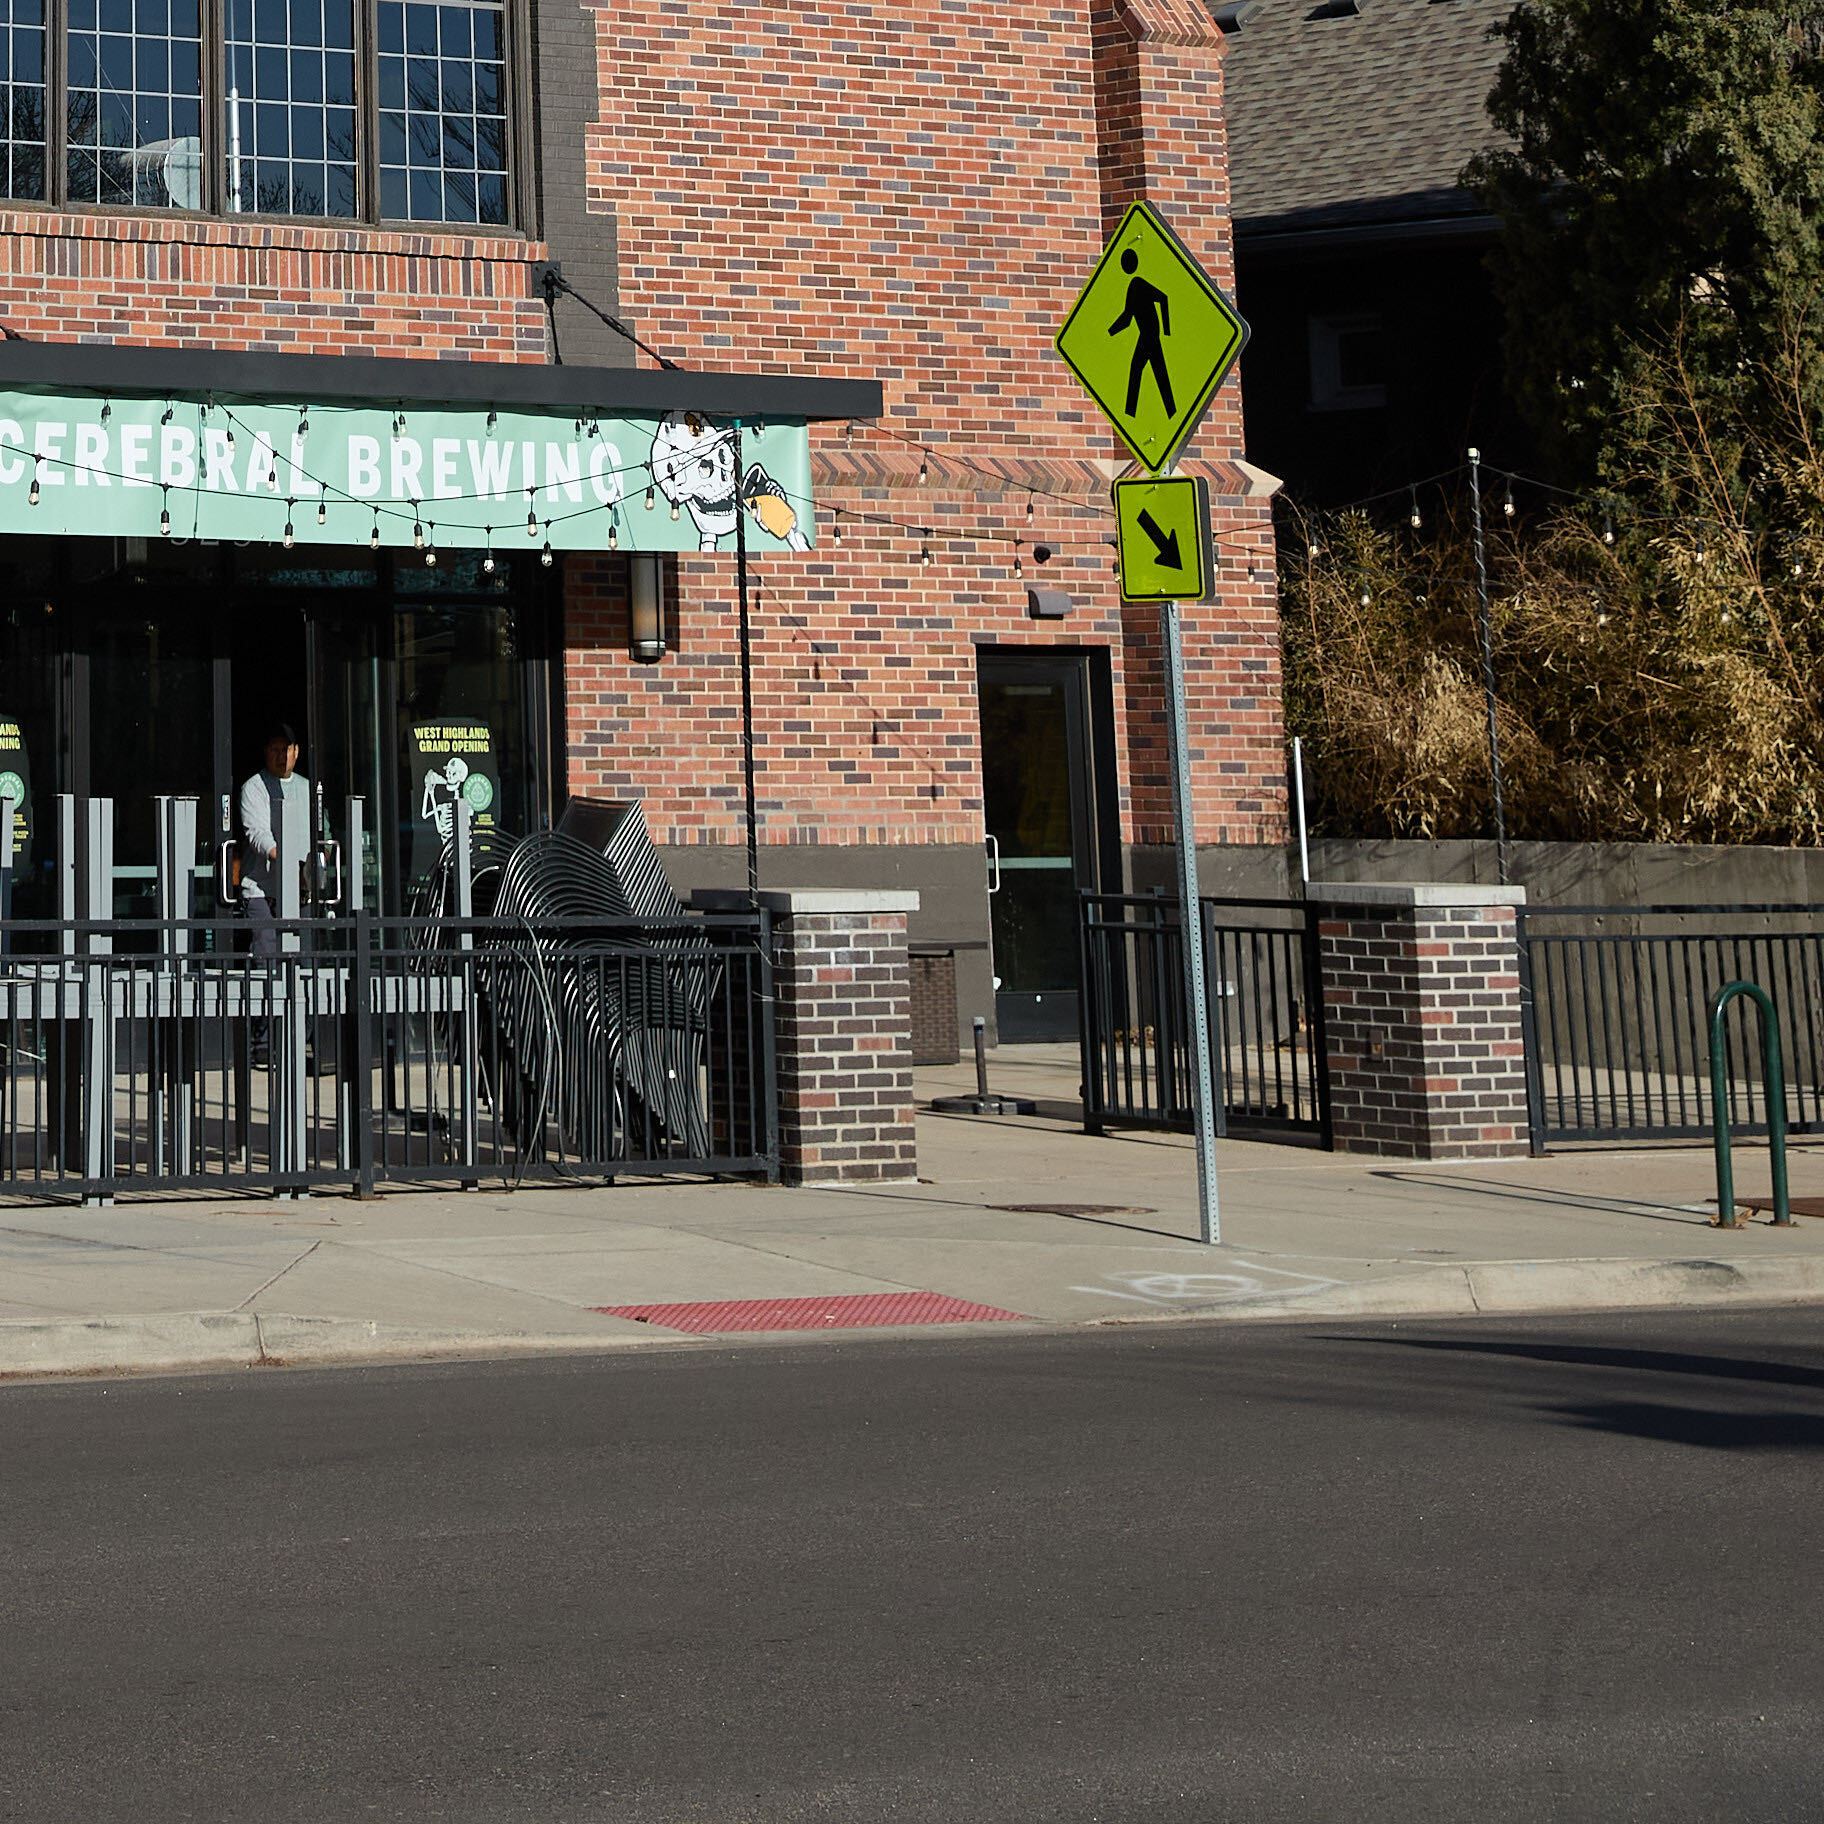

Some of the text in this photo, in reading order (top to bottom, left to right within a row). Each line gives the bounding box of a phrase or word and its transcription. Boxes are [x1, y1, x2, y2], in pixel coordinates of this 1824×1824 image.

[348, 434, 623, 503] BREWING
[414, 726, 490, 740] WEST HIGHLANDS
[419, 740, 490, 753] GRAND OPENING
